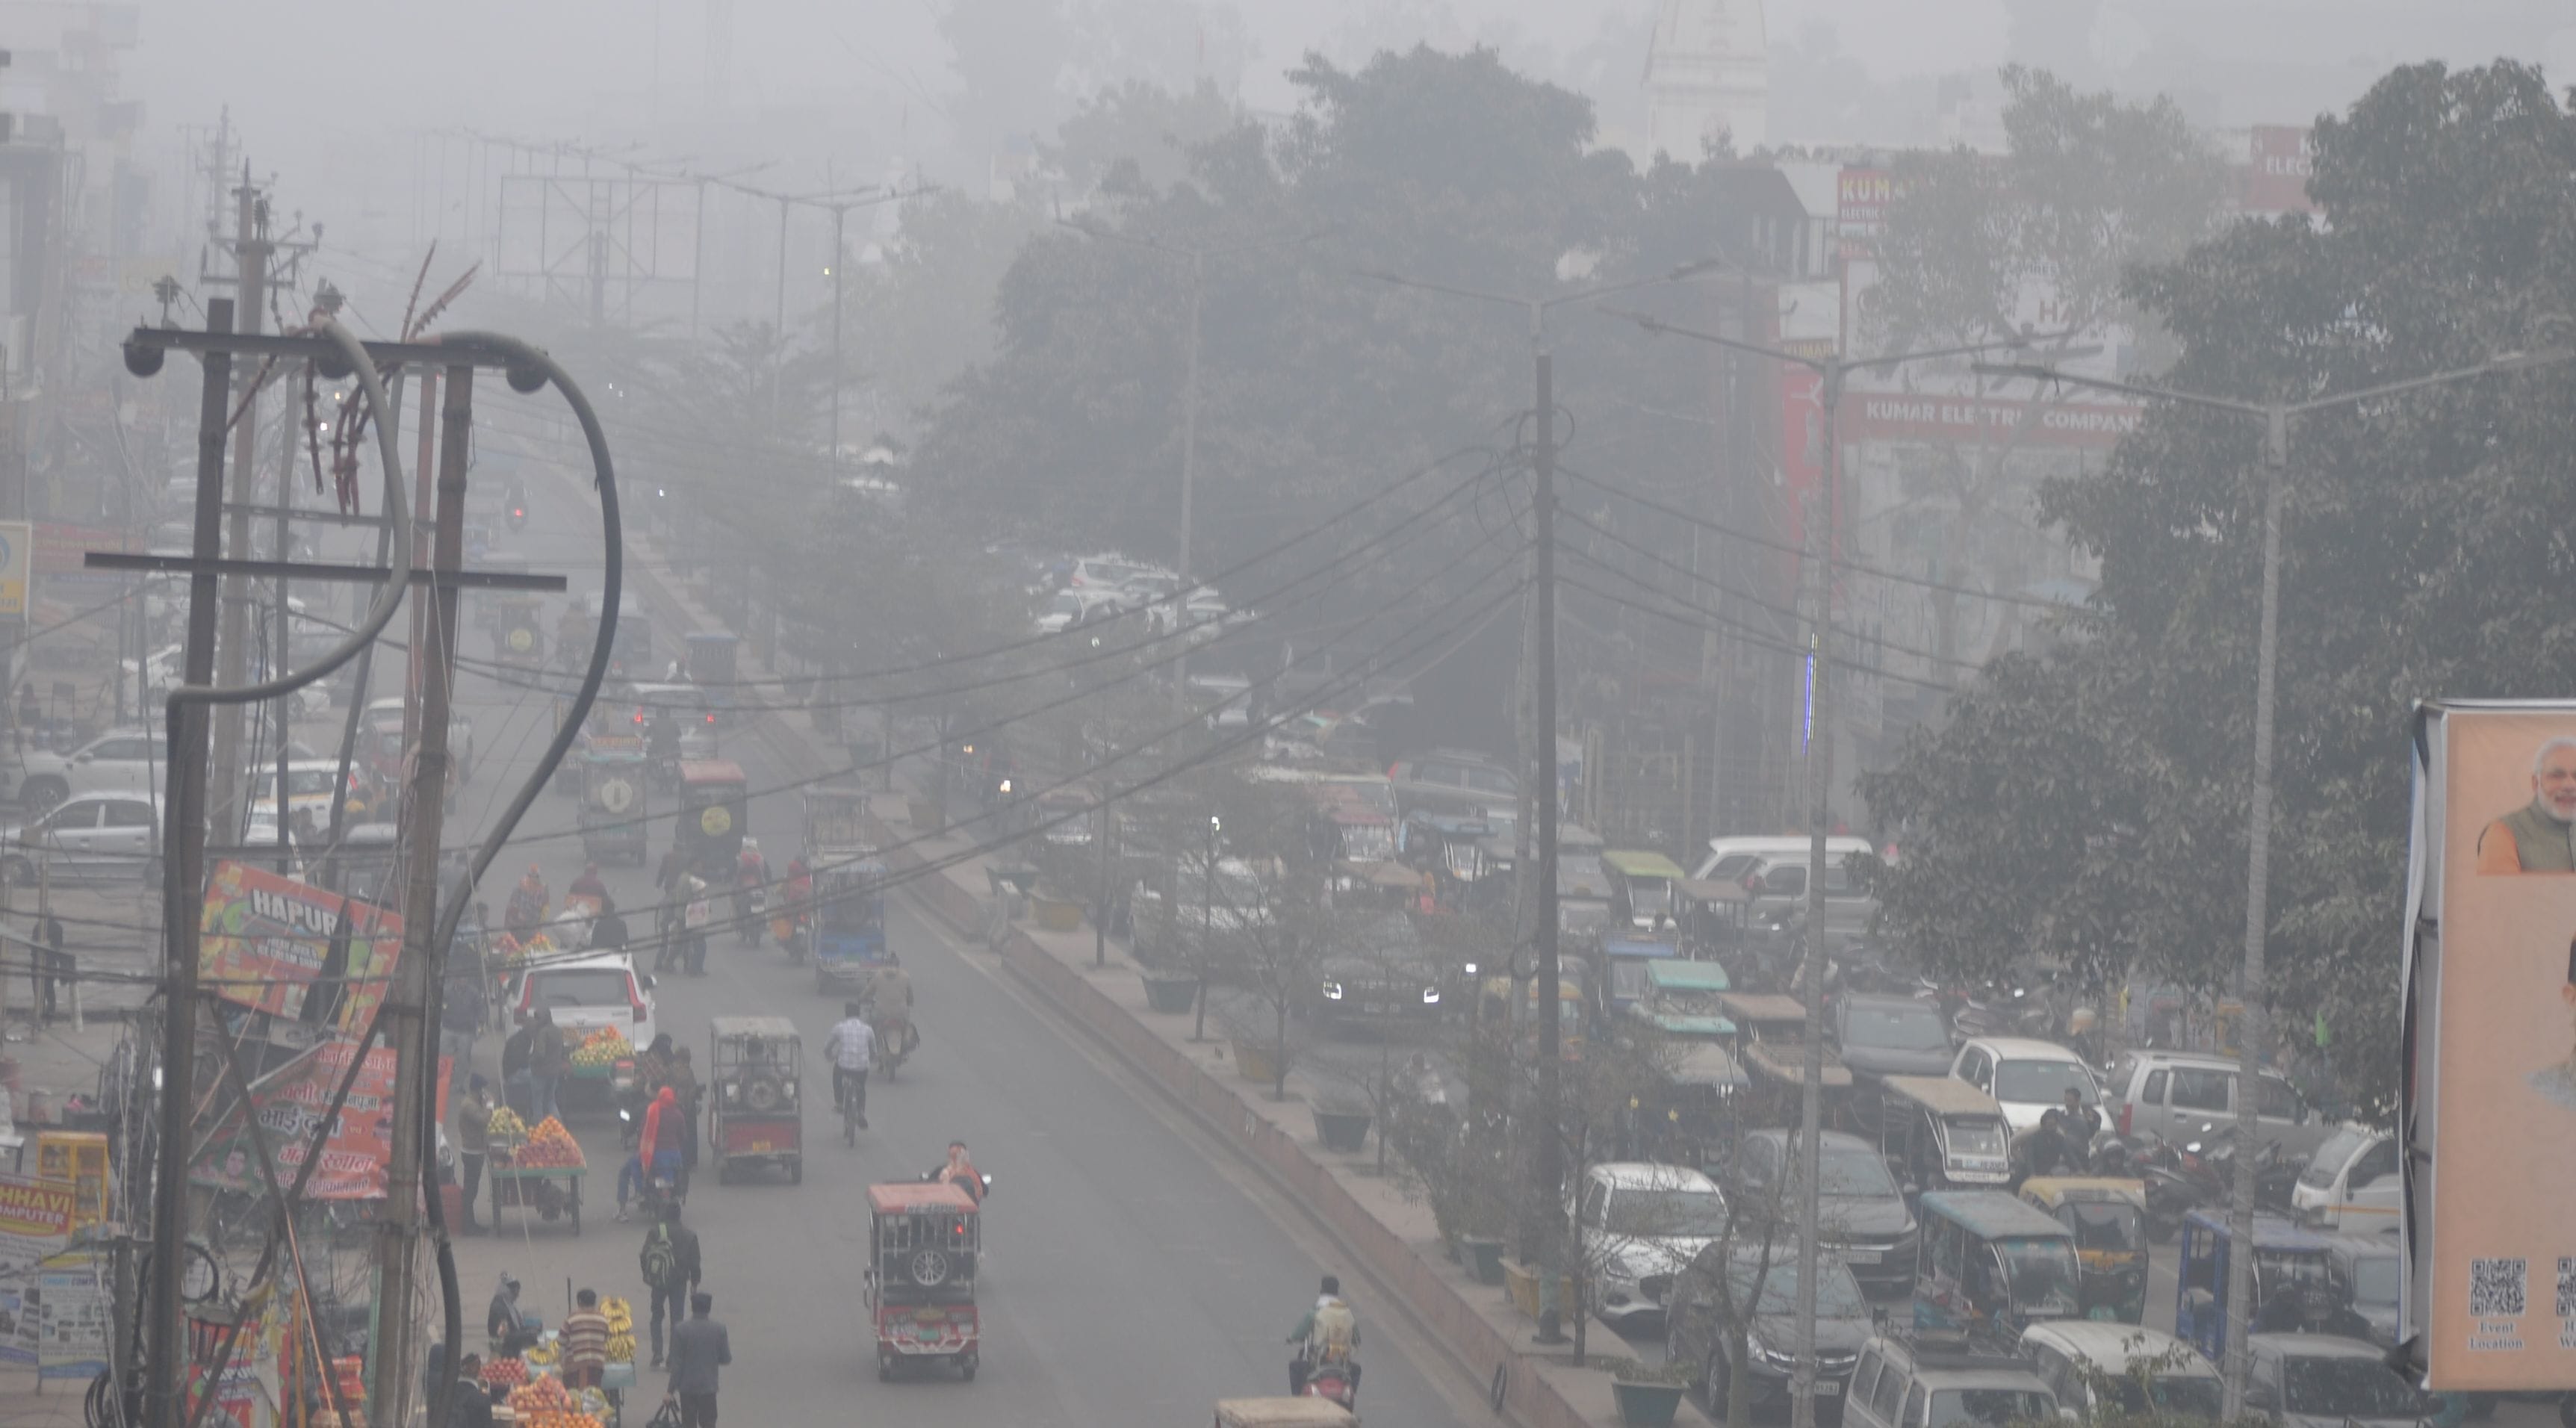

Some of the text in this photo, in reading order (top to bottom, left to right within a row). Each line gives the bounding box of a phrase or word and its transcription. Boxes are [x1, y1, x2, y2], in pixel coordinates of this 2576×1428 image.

[1866, 400, 1936, 423] KUMAR
[249, 888, 339, 937] HAPUR
[2480, 1321, 2515, 1334] Event
[2469, 1337, 2523, 1350] Location
